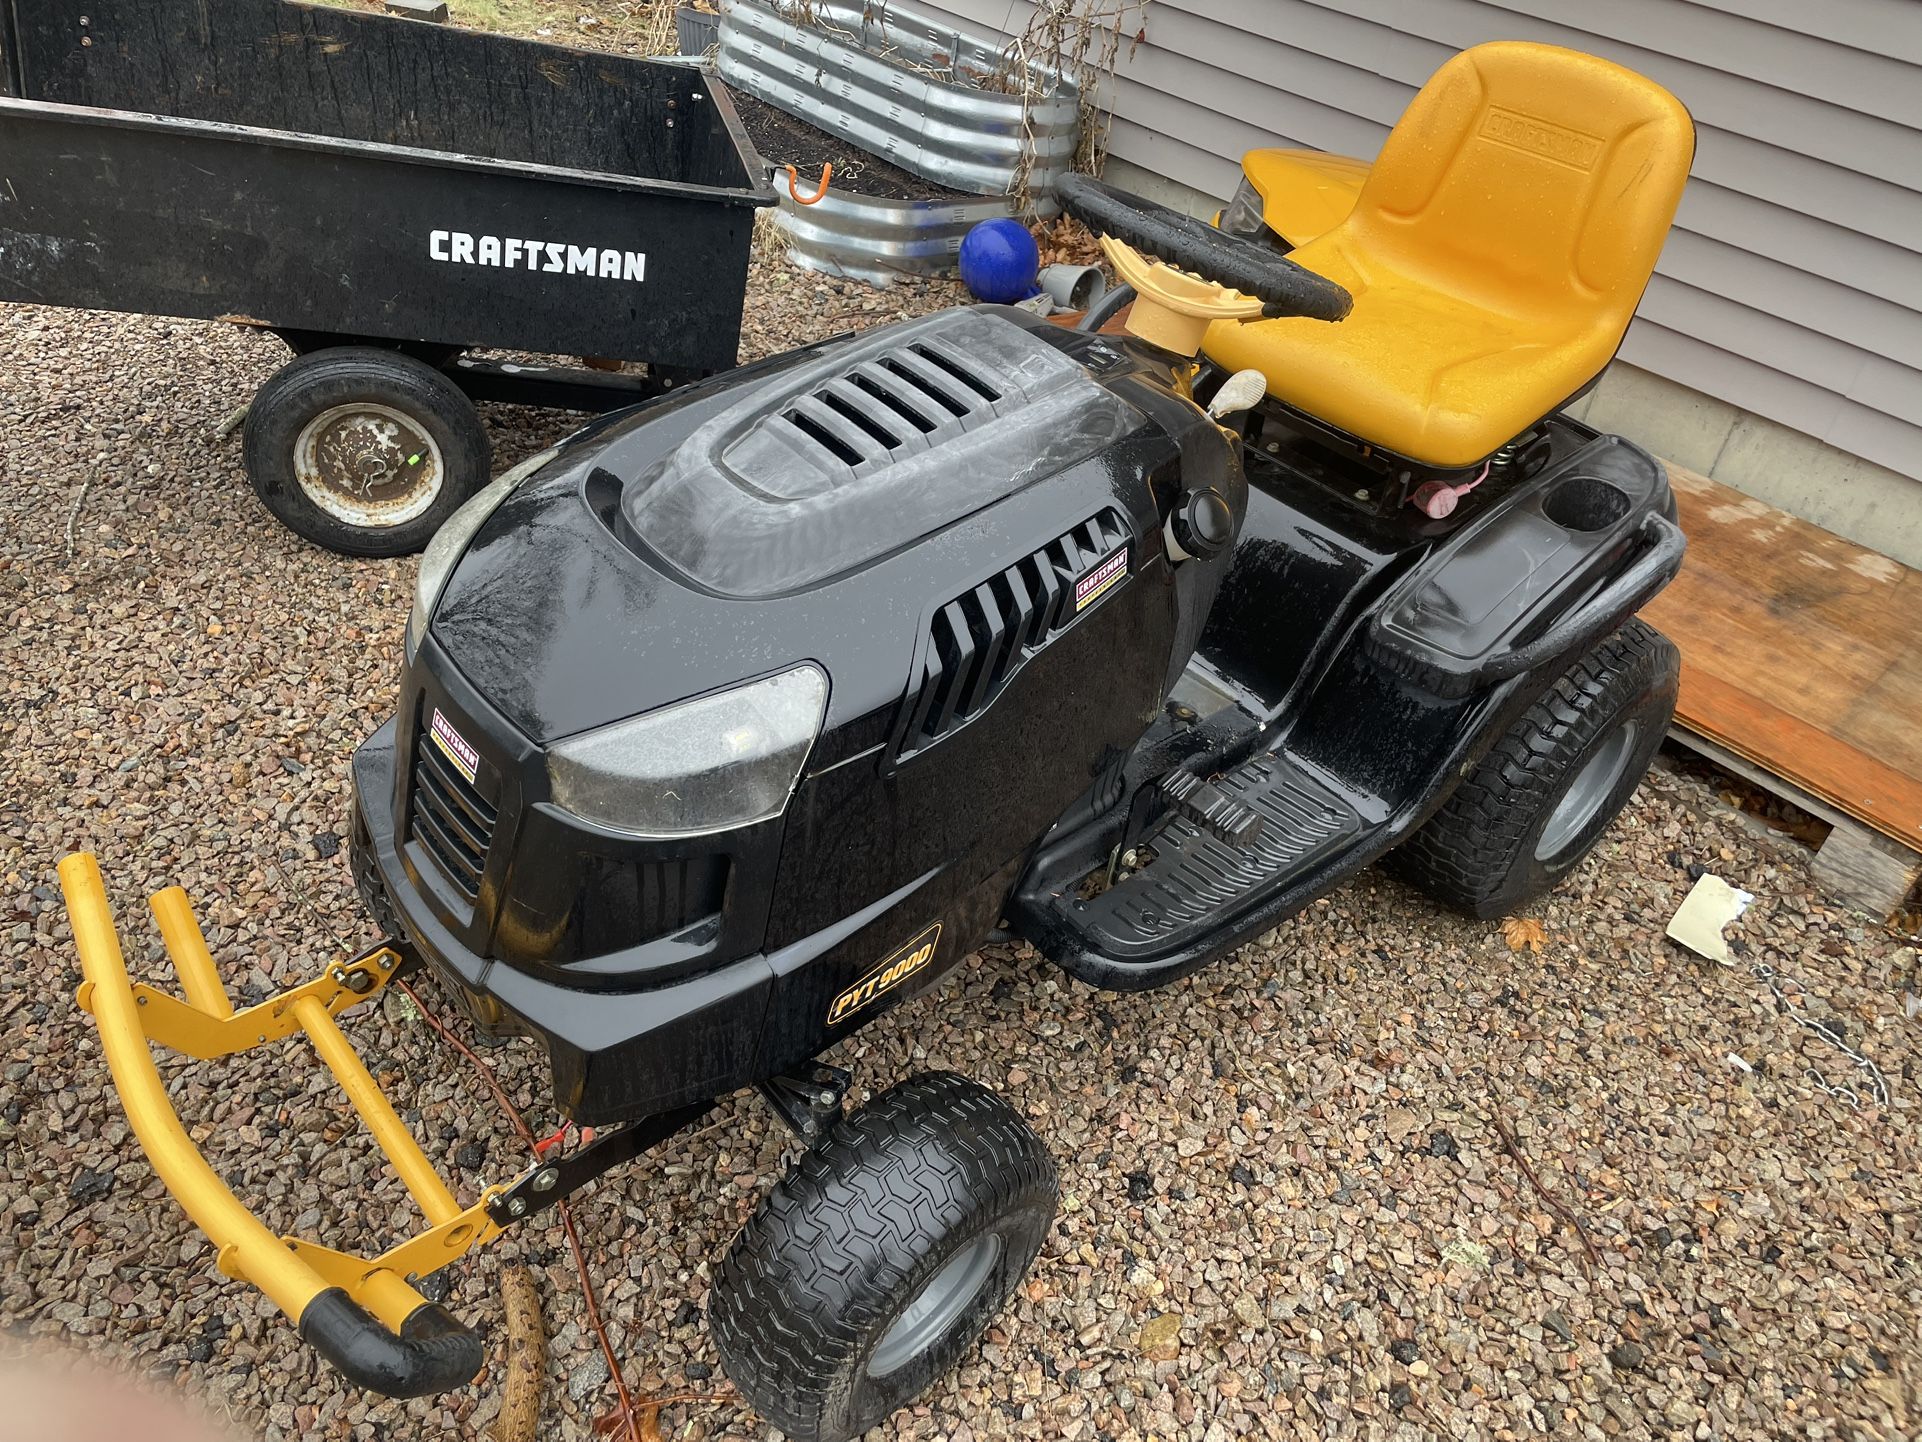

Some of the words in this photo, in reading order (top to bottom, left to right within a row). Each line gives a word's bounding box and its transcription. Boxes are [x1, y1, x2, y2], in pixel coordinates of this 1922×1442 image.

[429, 229, 646, 282] CRAFTSMAN
[1079, 552, 1125, 595] CRAFTSMAN
[434, 714, 476, 766] CRAFTSMAN
[834, 975, 880, 1017] PYT
[879, 943, 932, 989] 9000
